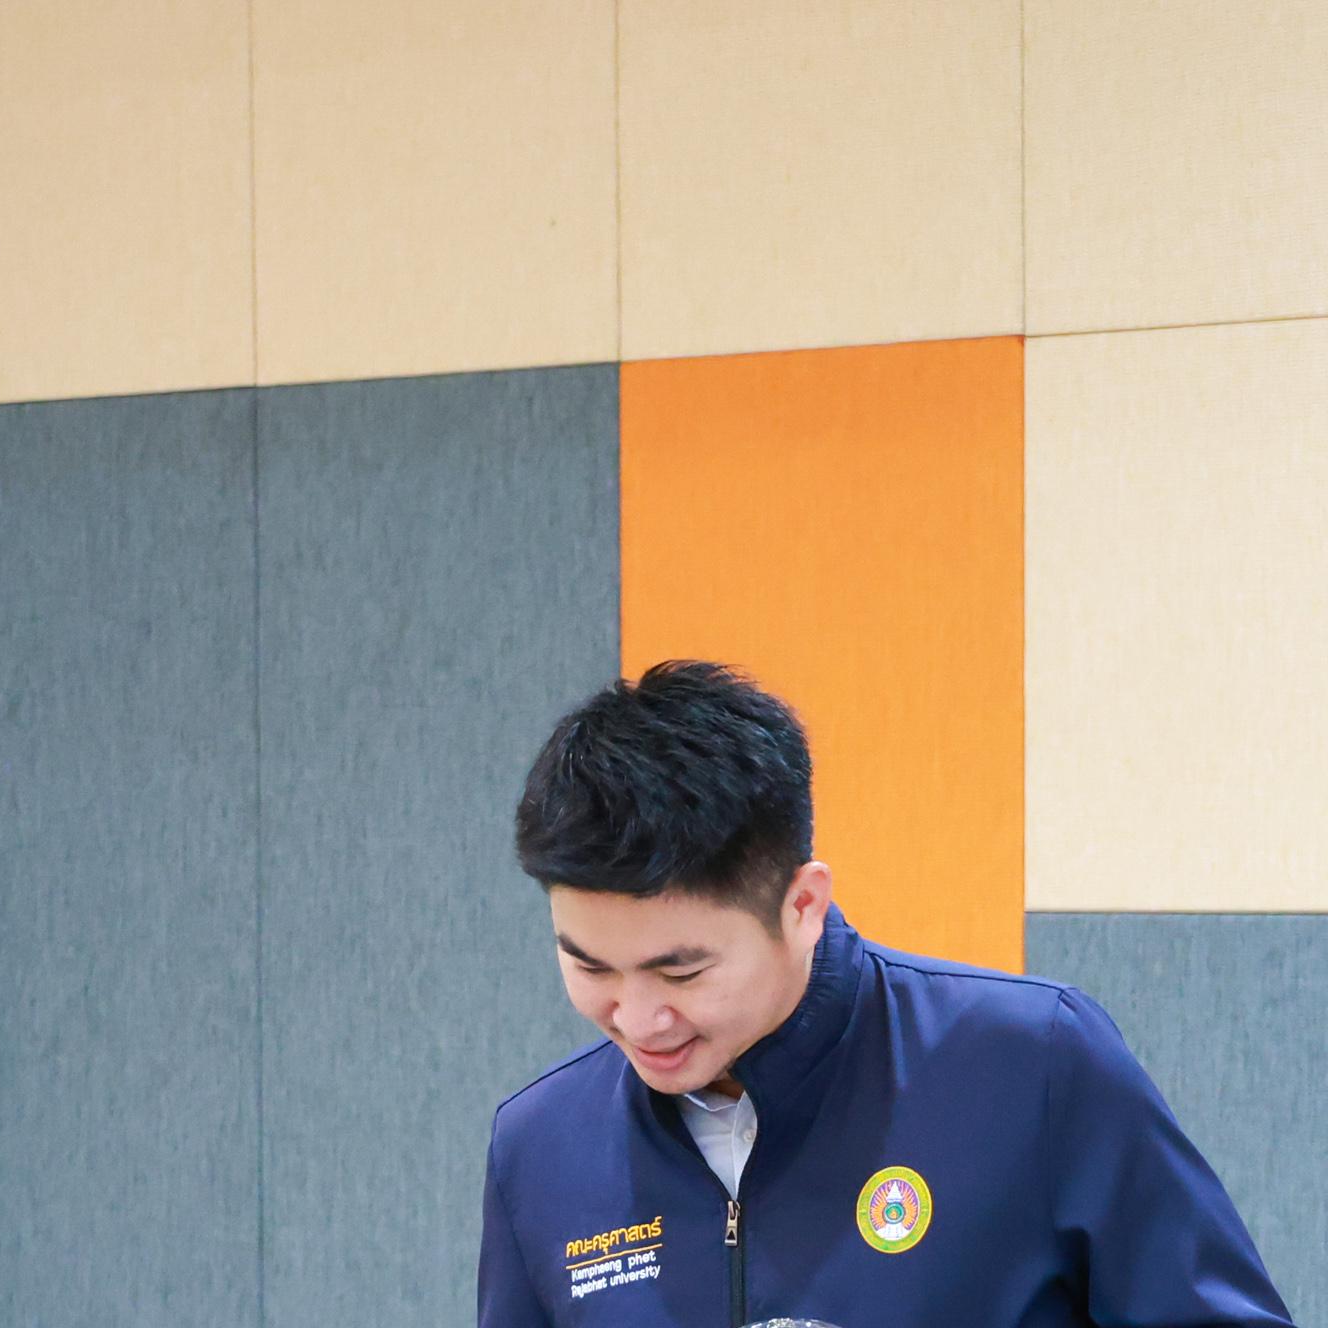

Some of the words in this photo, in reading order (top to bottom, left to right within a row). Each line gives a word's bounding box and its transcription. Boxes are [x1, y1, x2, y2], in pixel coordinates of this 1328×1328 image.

[566, 1216, 662, 1258] คณะครุศาสตร์
[628, 1250, 656, 1270] phet
[610, 1265, 661, 1287] university
